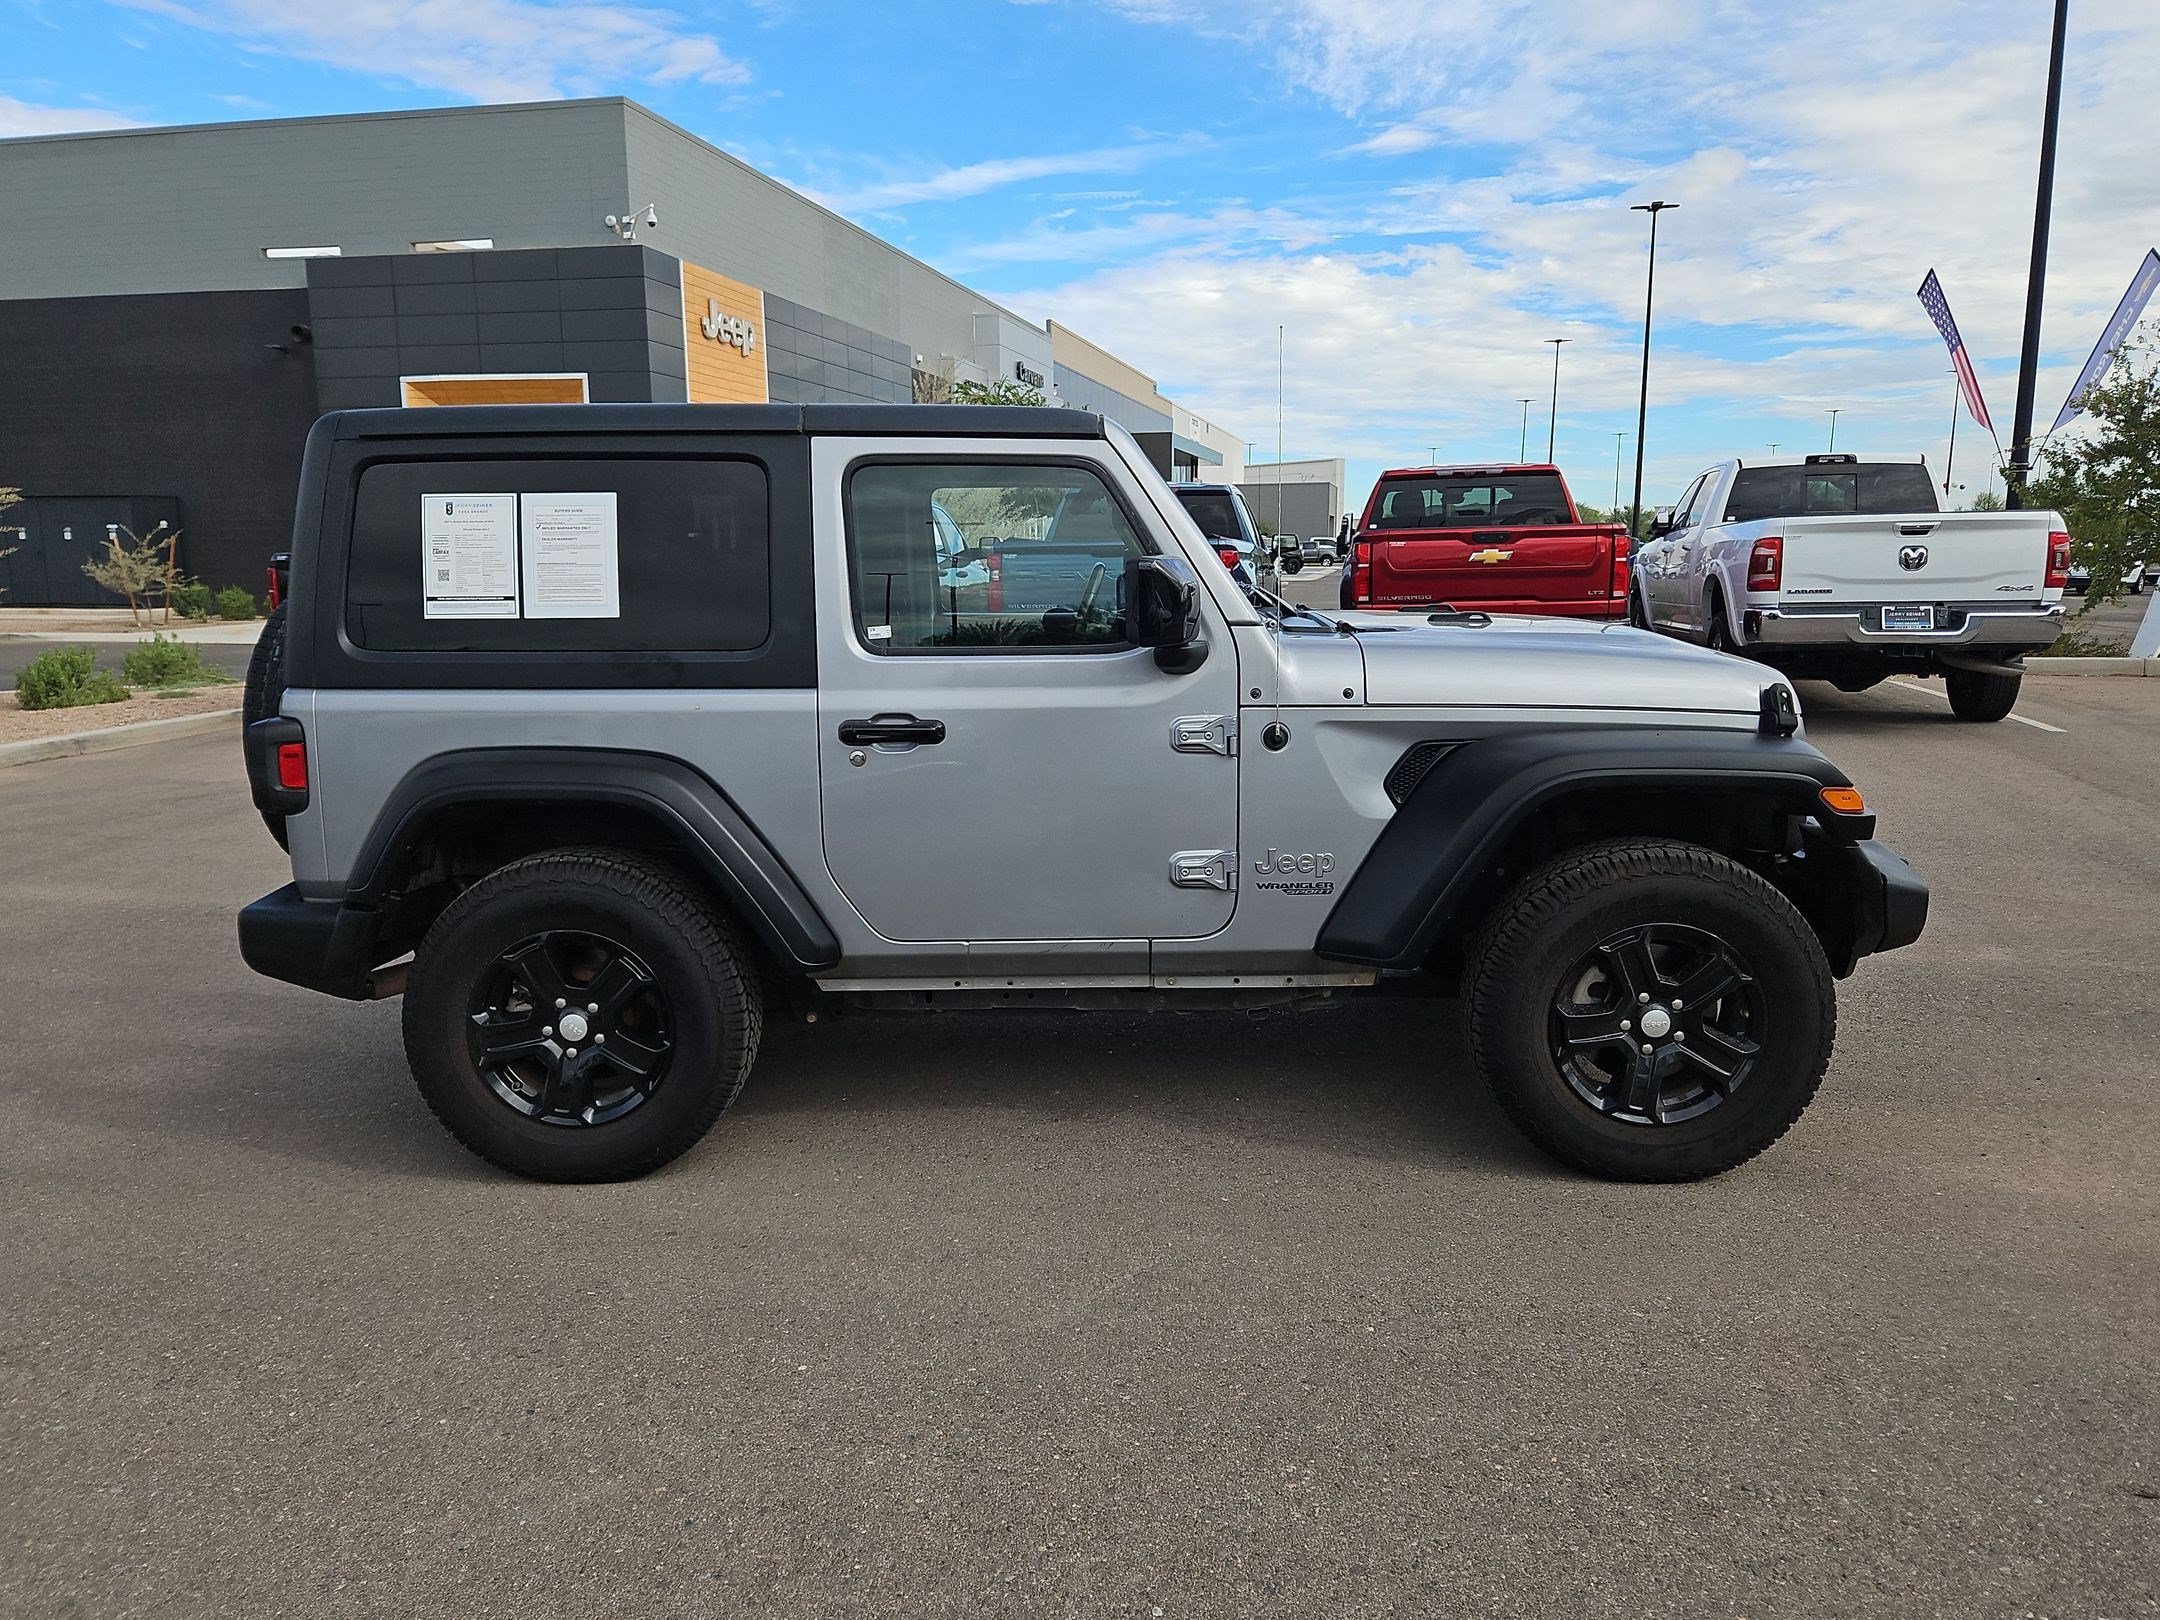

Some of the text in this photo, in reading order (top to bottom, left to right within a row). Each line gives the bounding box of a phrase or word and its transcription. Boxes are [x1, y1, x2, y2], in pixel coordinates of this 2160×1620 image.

[700, 298, 755, 357] Jeep
[1255, 847, 1336, 879] Jeep
[1255, 882, 1335, 890] WRANGLER
